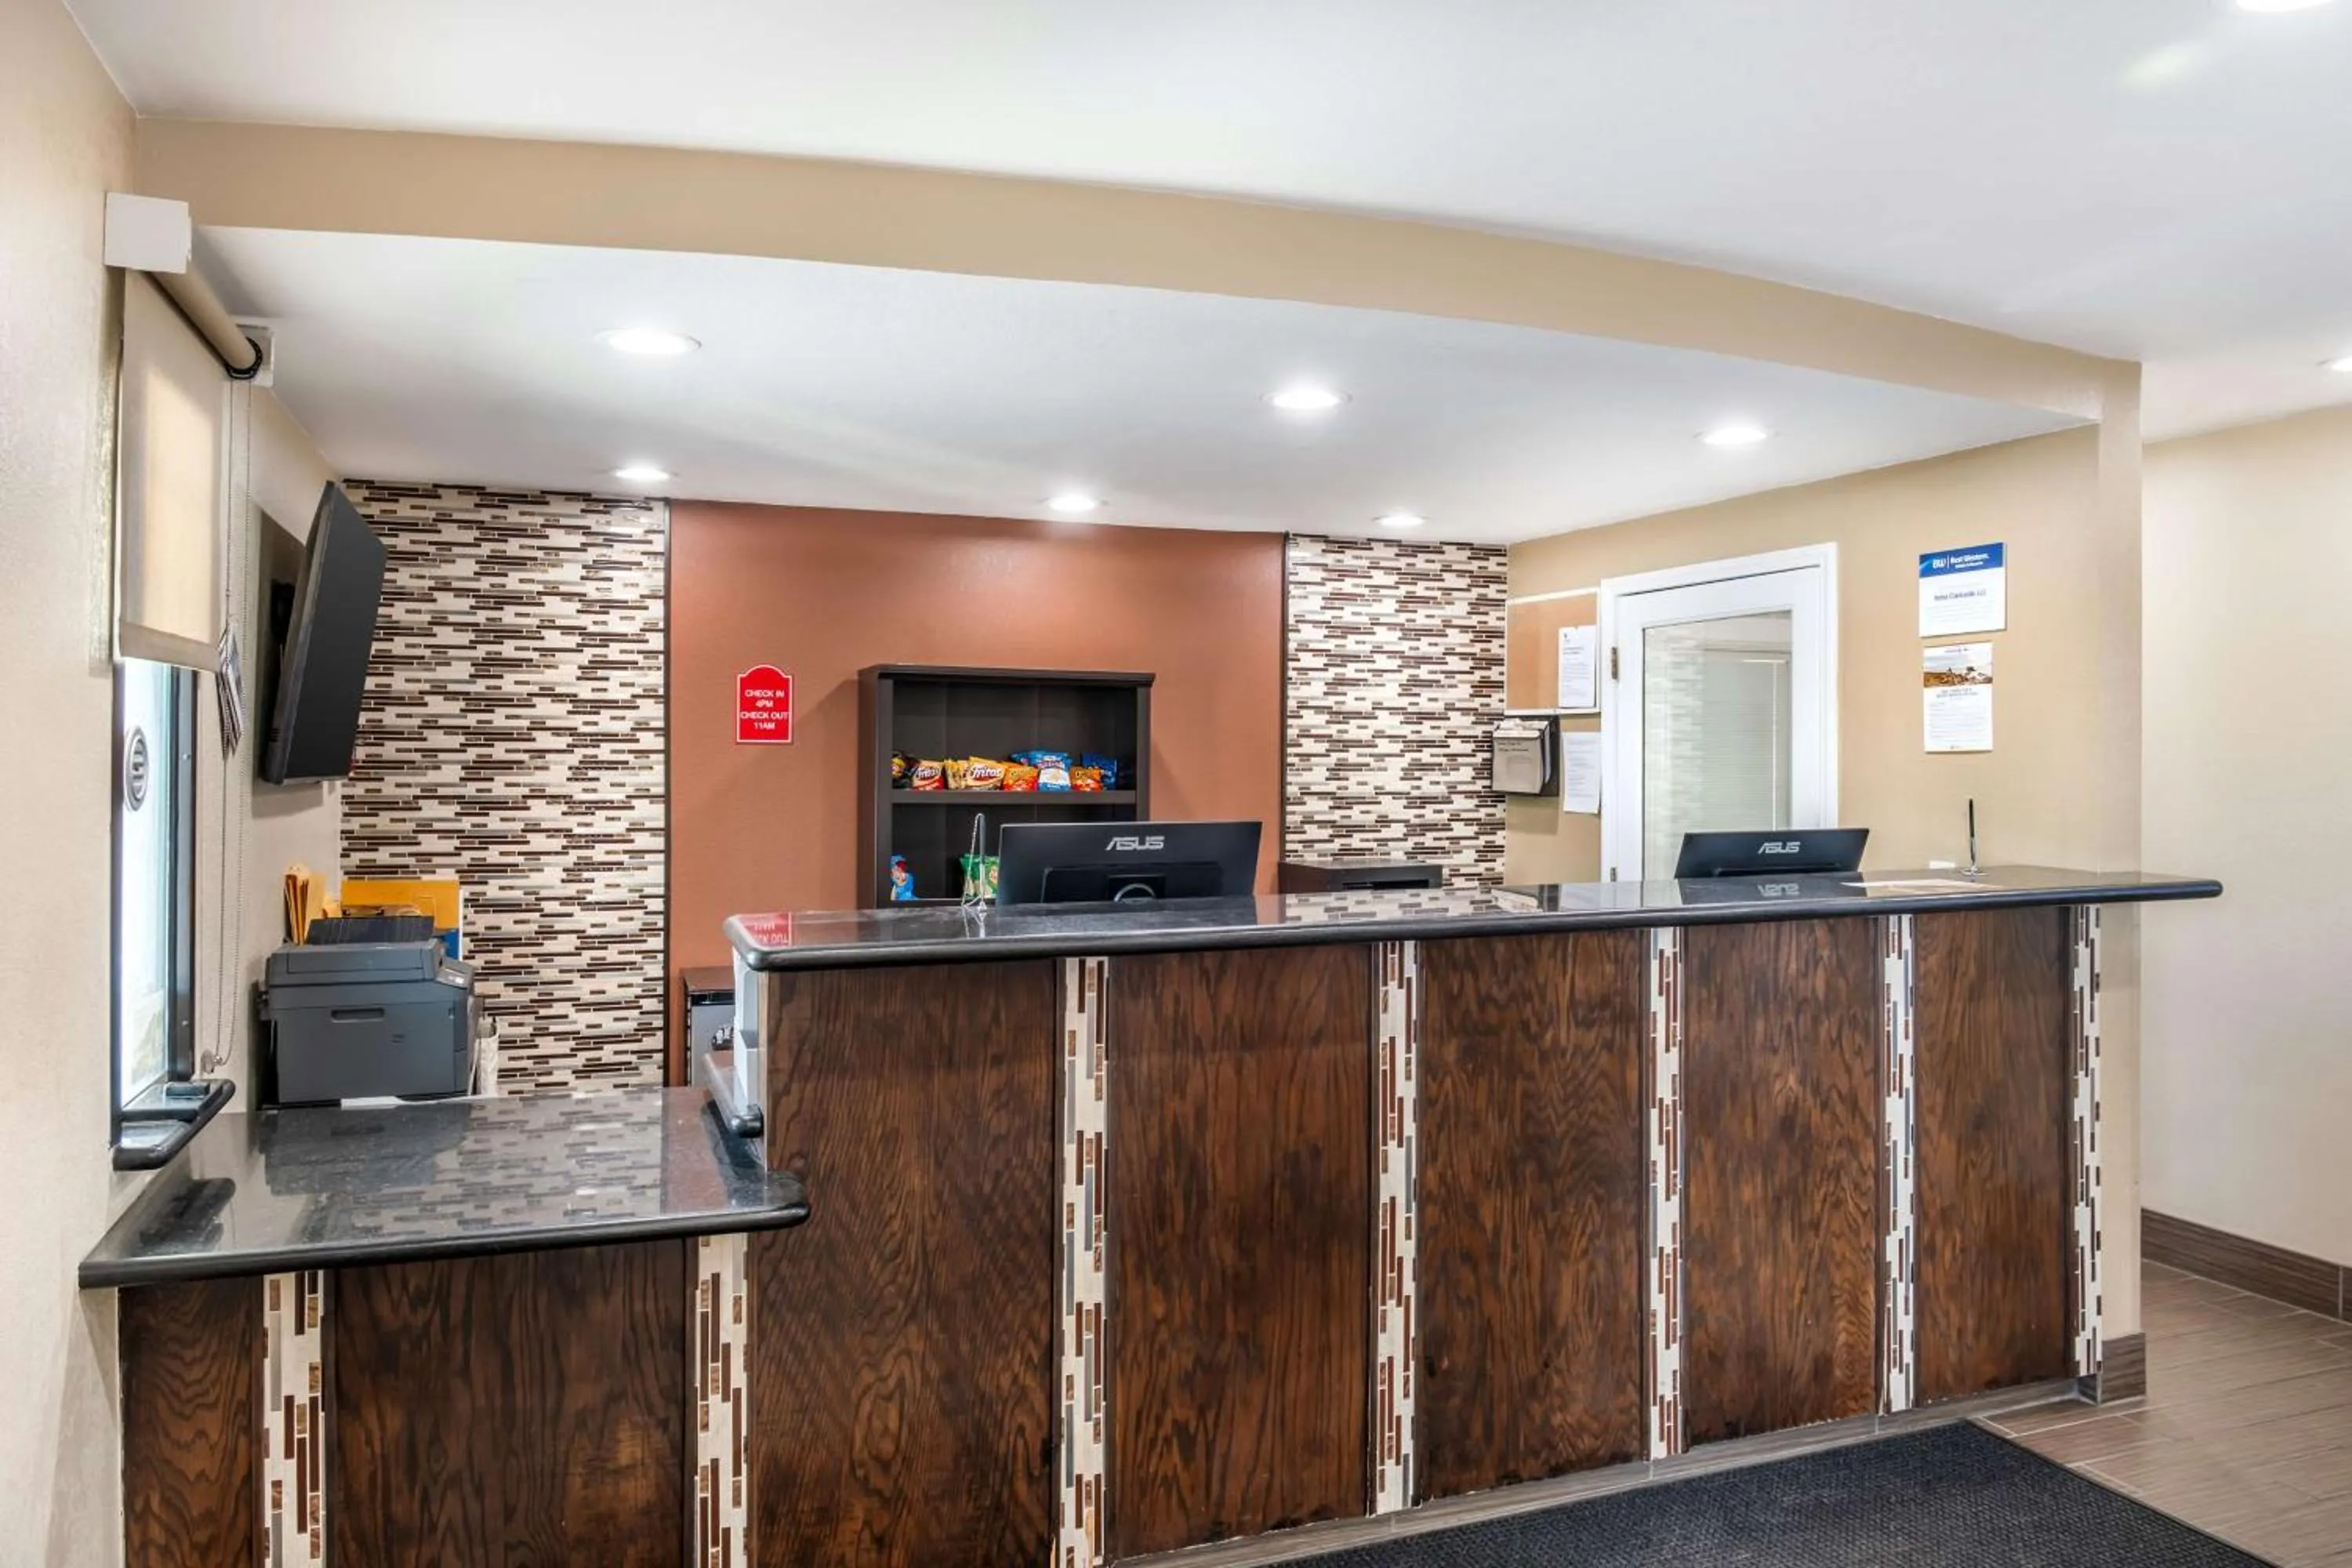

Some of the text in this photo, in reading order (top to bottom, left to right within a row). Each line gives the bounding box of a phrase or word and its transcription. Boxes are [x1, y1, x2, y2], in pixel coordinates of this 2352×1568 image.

[744, 689, 785, 698] CHECK IN
[755, 699, 774, 708] 4PM
[740, 711, 789, 720] CHECK OUT
[753, 721, 775, 730] 11AM
[971, 764, 1003, 779] Fritos
[1105, 836, 1165, 851] ASUS
[1758, 841, 1801, 854] ASUS
